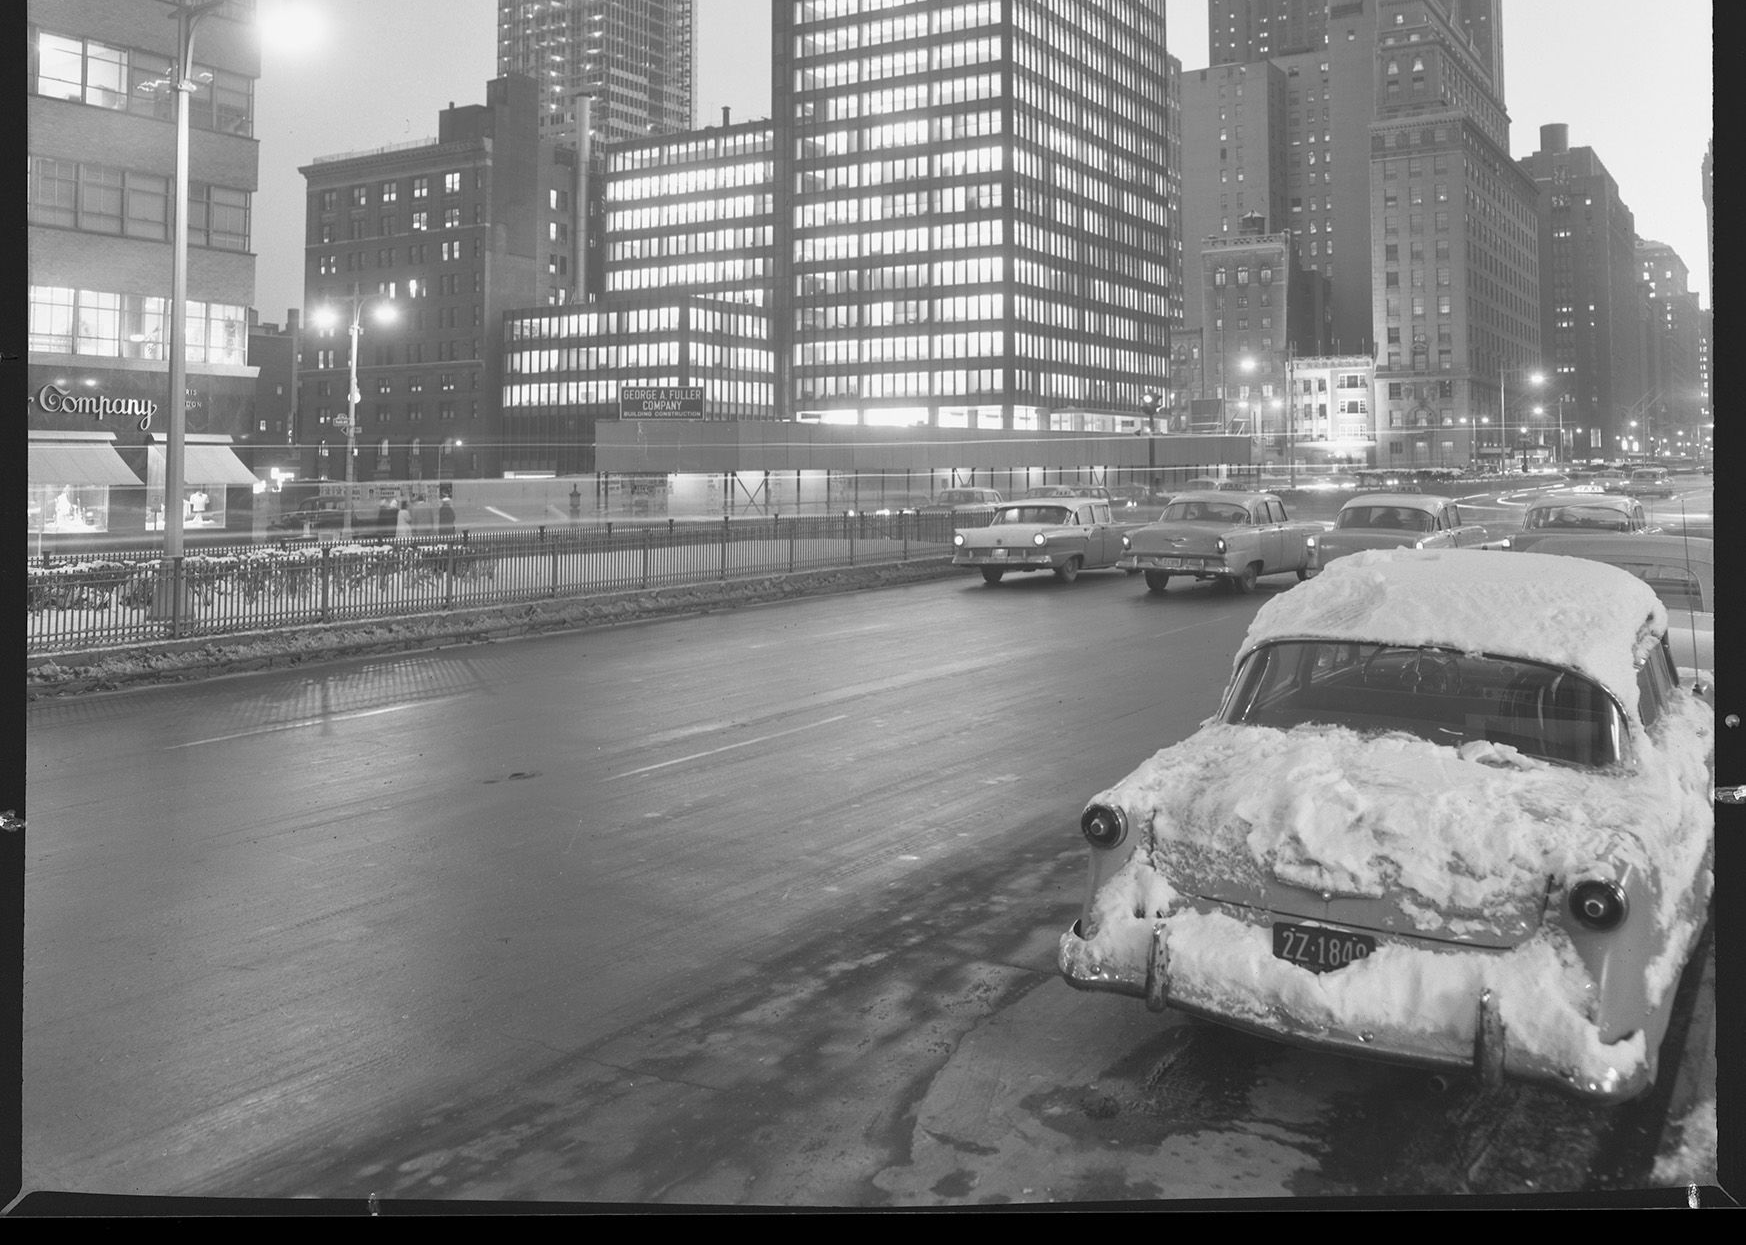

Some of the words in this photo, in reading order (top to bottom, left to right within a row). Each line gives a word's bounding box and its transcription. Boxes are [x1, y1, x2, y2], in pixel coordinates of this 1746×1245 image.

[623, 389, 657, 401] GEORGE
[660, 389, 668, 401] A.
[669, 389, 701, 401] FULLER
[39, 383, 158, 431] Company
[642, 401, 682, 411] COMPANY
